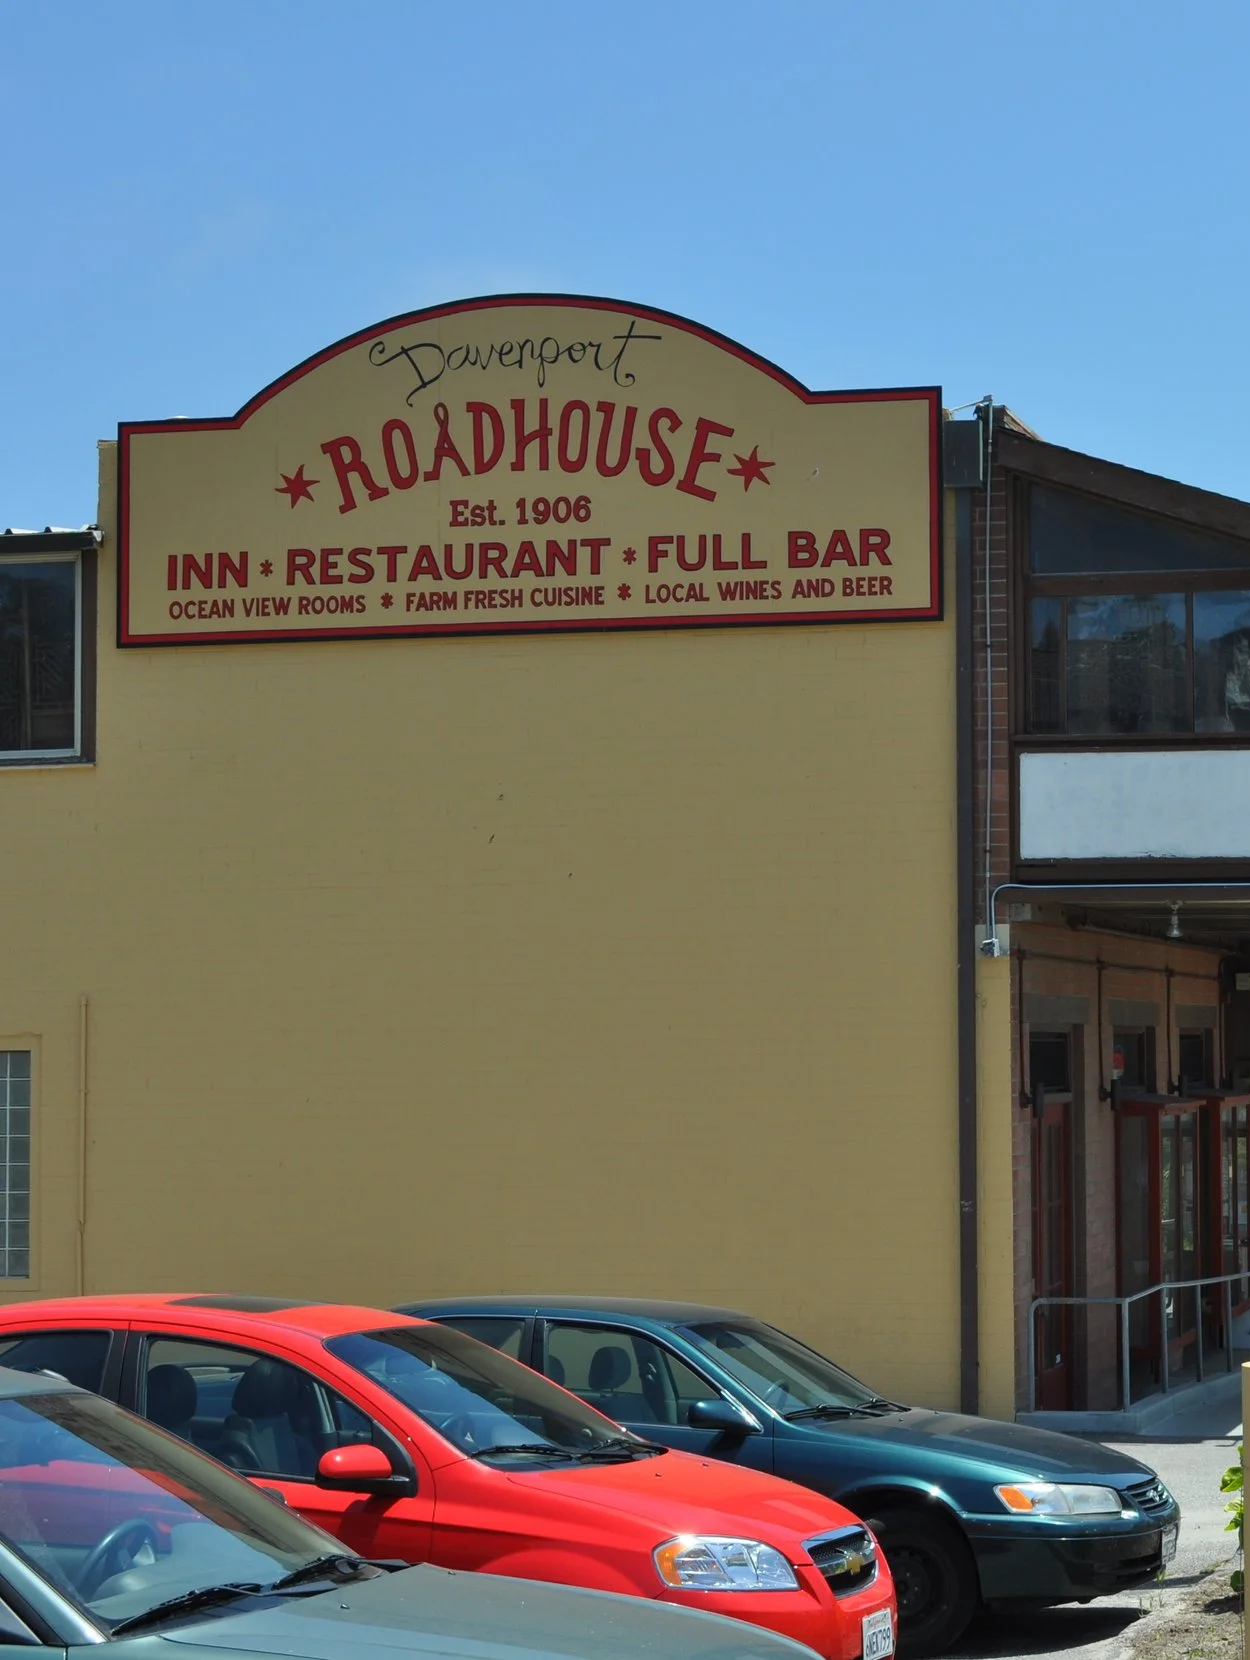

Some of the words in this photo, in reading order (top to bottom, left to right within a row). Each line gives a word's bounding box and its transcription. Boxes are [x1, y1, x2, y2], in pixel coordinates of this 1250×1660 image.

[368, 320, 662, 407] Davenport
[321, 398, 735, 513] ROADHOUSE
[449, 499, 505, 527] Est.
[515, 495, 592, 525] 1906
[167, 551, 249, 590] INN
[286, 538, 612, 585] RESTAURANT
[648, 532, 768, 573] FULL
[787, 528, 893, 568] BAR
[169, 598, 235, 620] OCEAN
[242, 597, 291, 617] VIEW
[298, 594, 367, 615] ROOMS
[406, 591, 458, 612] FARM
[464, 588, 524, 610] FRESH
[530, 586, 605, 607] CUISINE
[645, 582, 711, 604] LOCAL
[717, 580, 782, 600] WINES
[791, 578, 835, 599] AND
[842, 576, 893, 597] BEER
